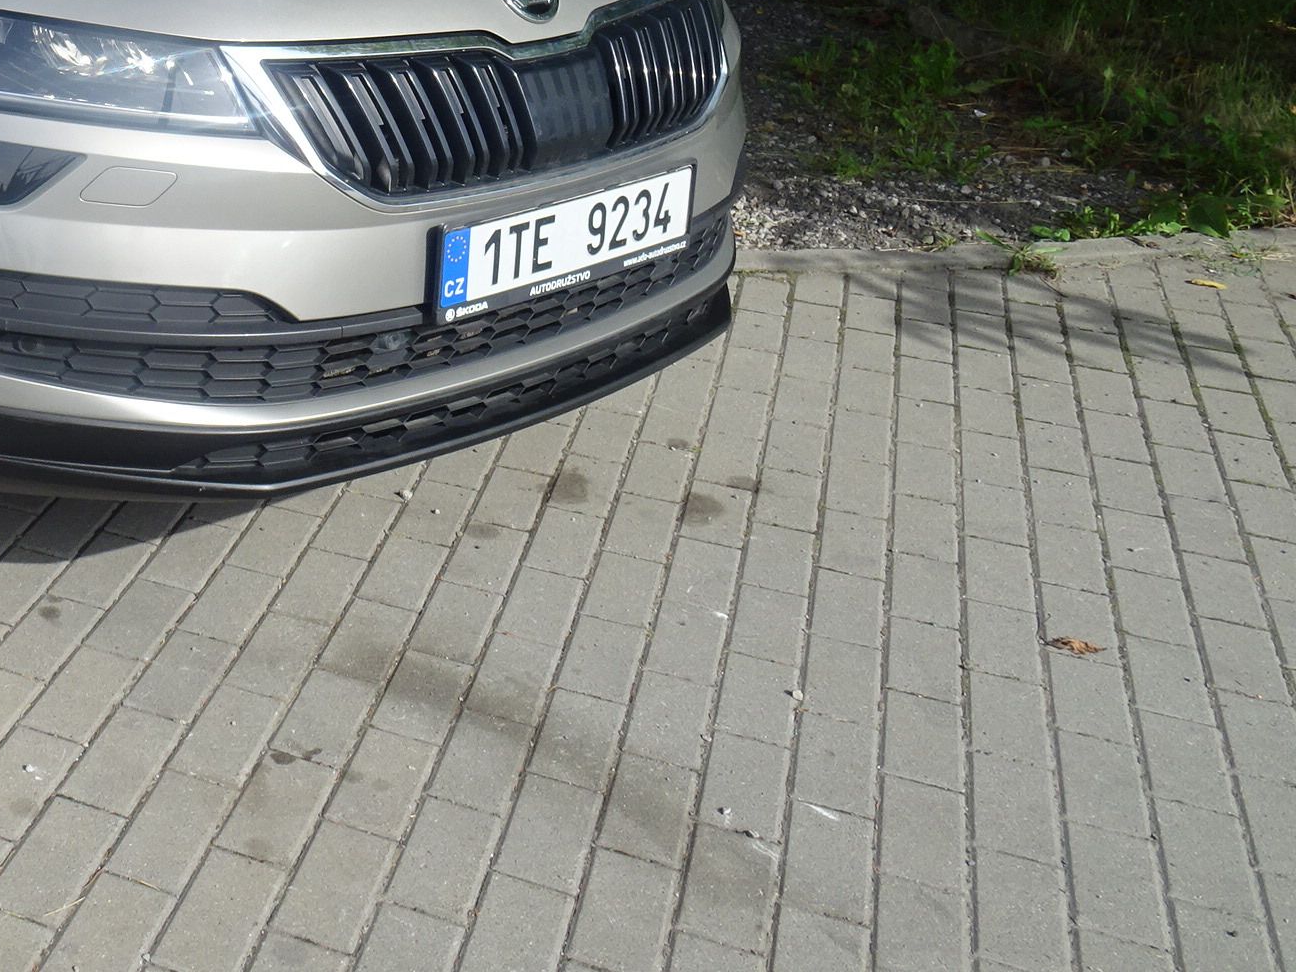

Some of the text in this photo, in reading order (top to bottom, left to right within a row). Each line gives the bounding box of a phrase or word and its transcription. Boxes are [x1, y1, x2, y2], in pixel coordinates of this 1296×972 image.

[484, 182, 672, 285] 1TE 9234
[444, 277, 465, 298] CZ
[529, 270, 591, 297] AUTODRUŽSTVO
[455, 301, 489, 318] ŠKODA
